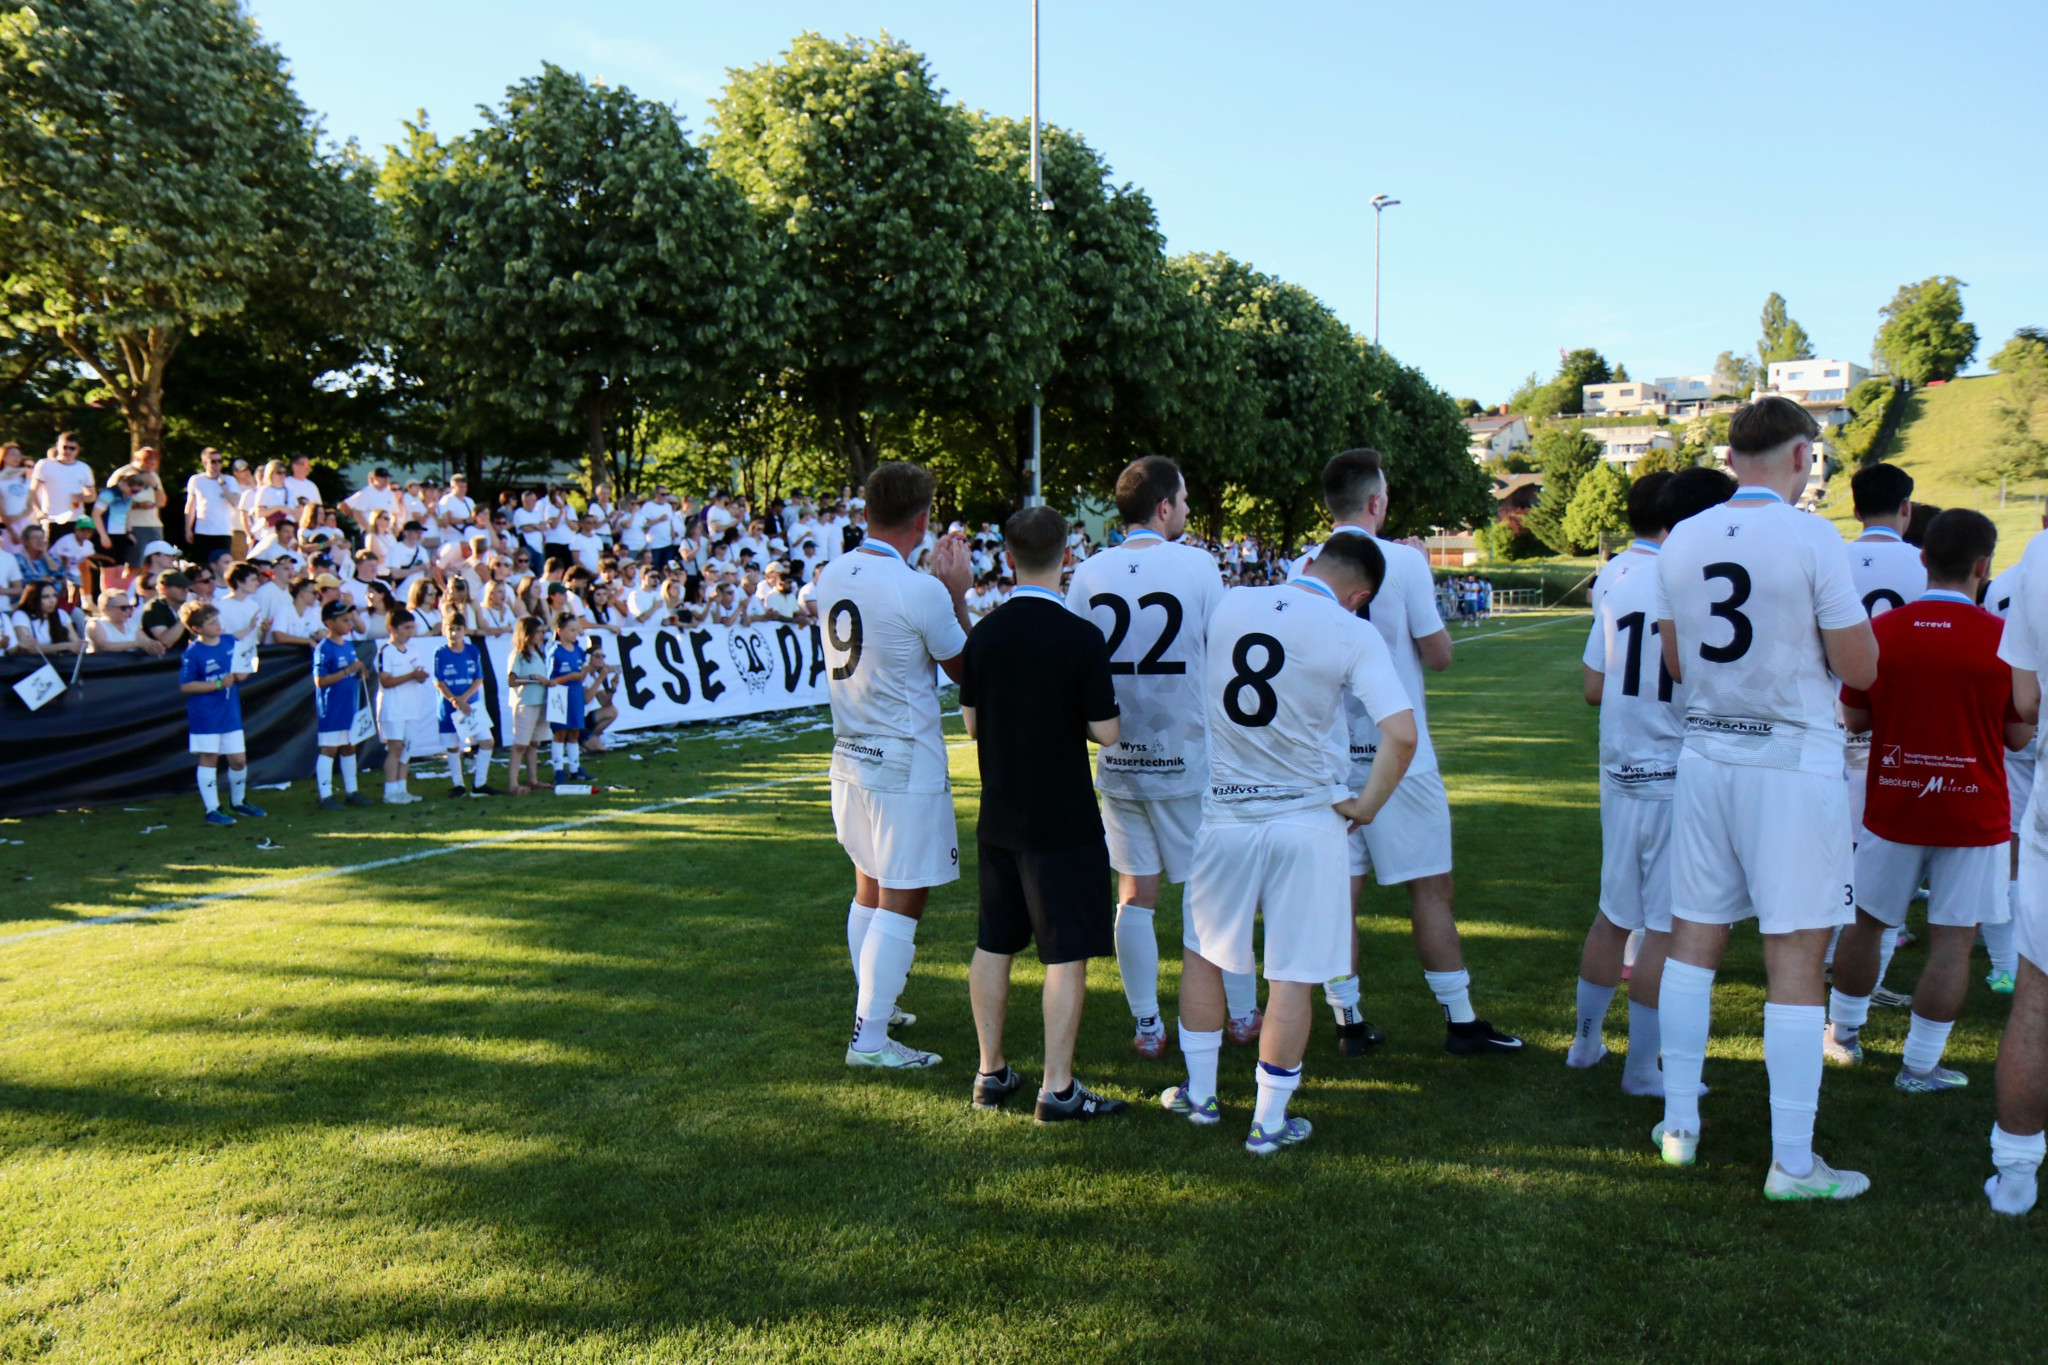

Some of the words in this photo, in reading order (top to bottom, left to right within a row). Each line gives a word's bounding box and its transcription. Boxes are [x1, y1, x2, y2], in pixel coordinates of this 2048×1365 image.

[1089, 592, 1187, 675] 22
[1699, 562, 1753, 663] 3
[1913, 620, 1952, 629] acrevis
[828, 599, 863, 680] 9
[1616, 611, 1674, 703] 11
[1223, 632, 1286, 728] 8
[1105, 756, 1185, 767] Wassertechnik
[1120, 741, 1147, 753] Wyss
[951, 847, 958, 865] 9
[1844, 884, 1854, 906] 3
